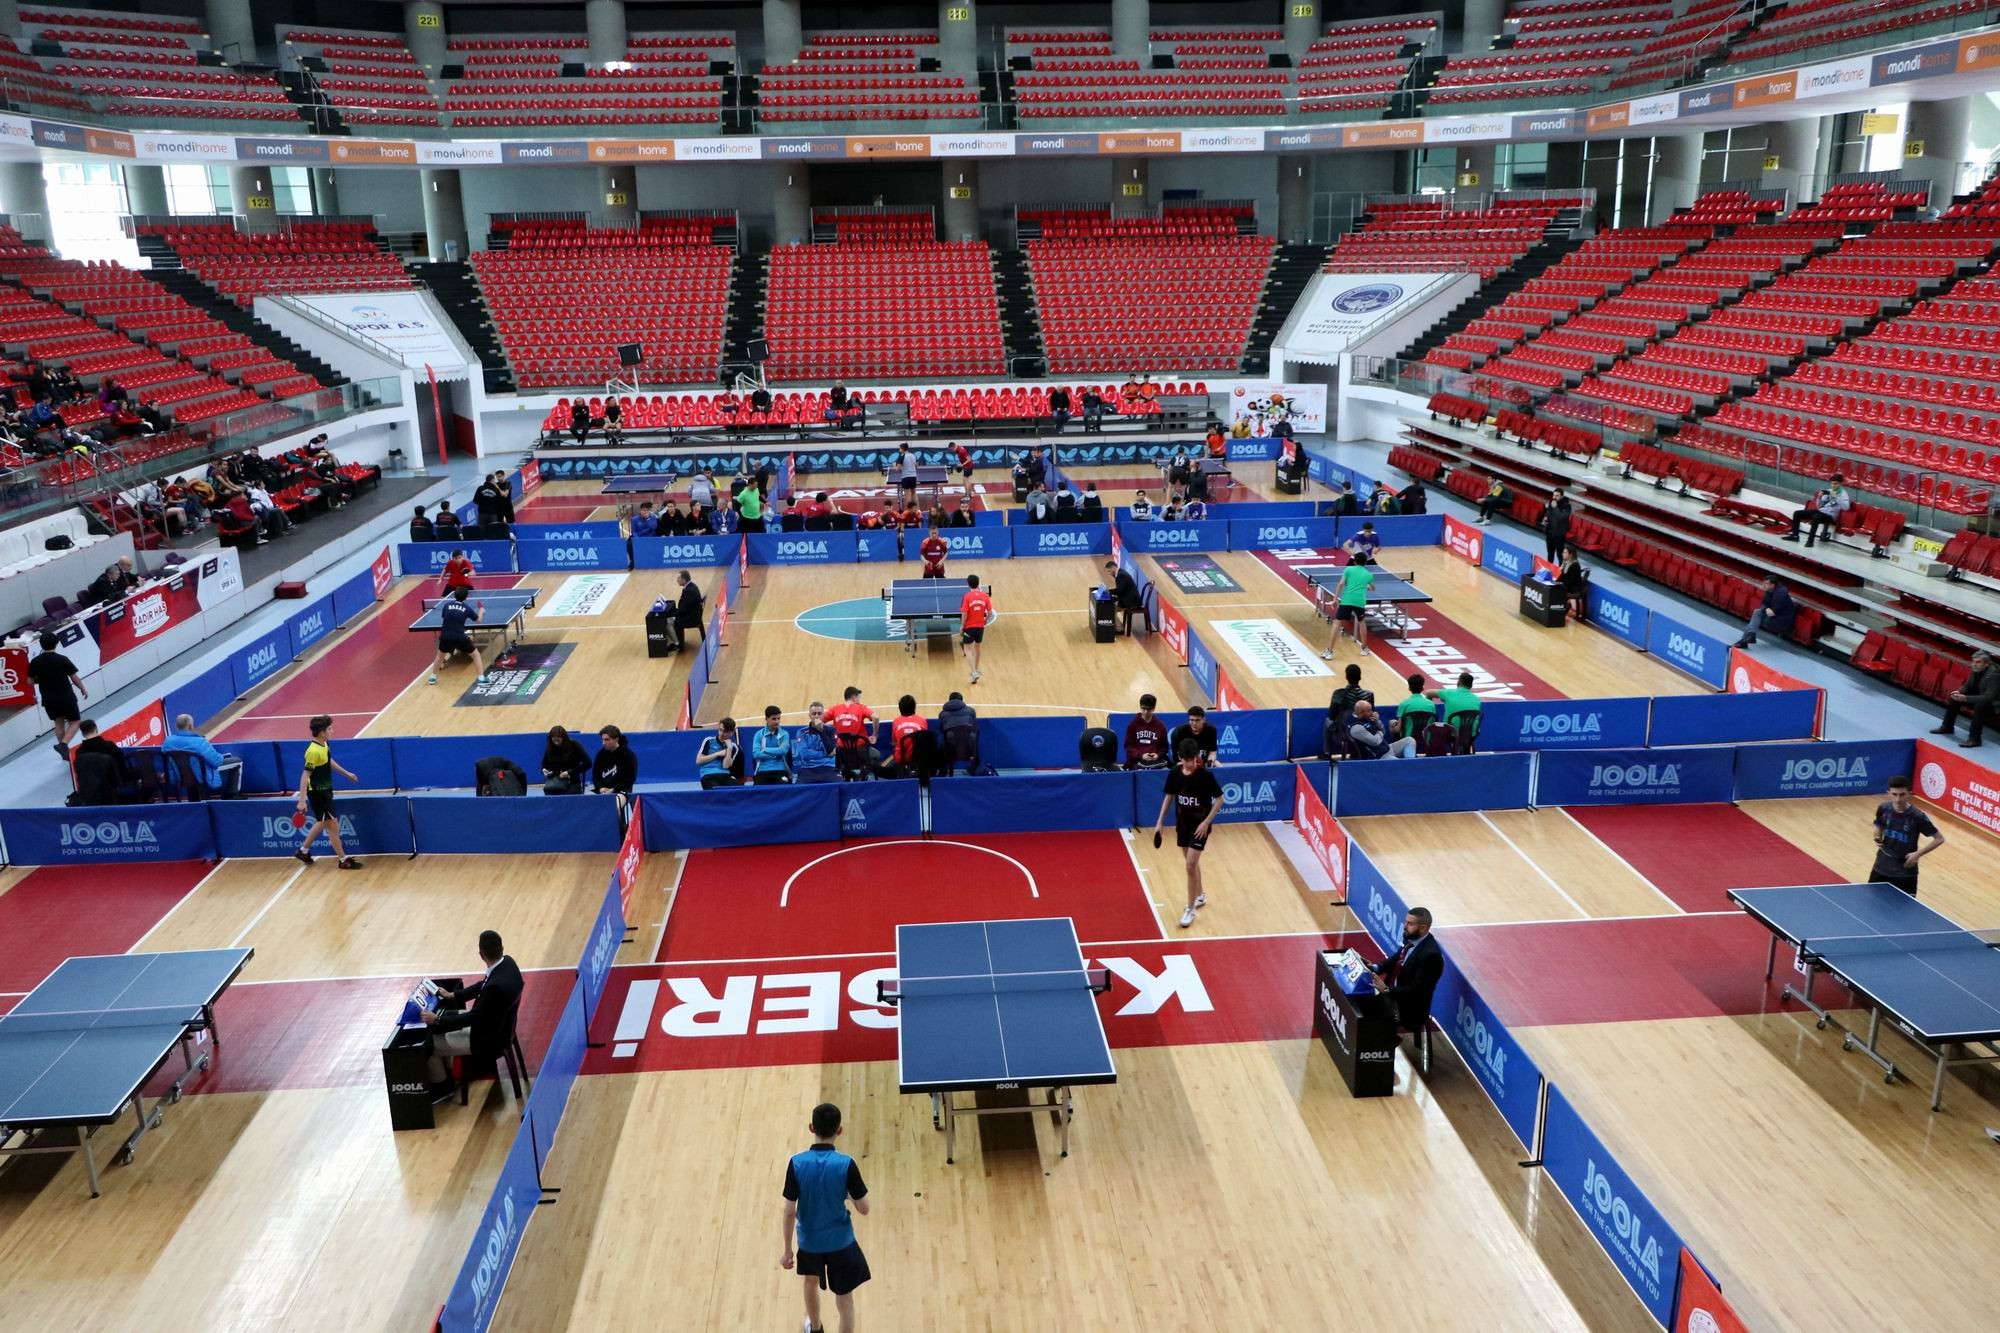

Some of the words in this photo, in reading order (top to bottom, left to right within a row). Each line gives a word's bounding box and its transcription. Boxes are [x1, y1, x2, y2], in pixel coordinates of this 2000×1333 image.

[950, 10, 967, 19] 220
[1294, 6, 1311, 15] 219
[420, 16, 438, 25] 221
[1887, 48, 1951, 75] mondihome
[1811, 67, 1866, 88] mondihome
[1443, 122, 1505, 136] mondihome
[948, 139, 1009, 150] mondihome
[1199, 135, 1257, 146] mondihome
[157, 141, 228, 155] mondihome
[693, 144, 754, 155] mondihome
[251, 199, 270, 208] 122
[1232, 444, 1267, 454] JOOLA
[1039, 532, 1088, 546] JOOLA
[1149, 530, 1199, 543] JOOLA
[1258, 526, 1307, 540] JOOLA
[547, 548, 598, 561] JOOLA
[664, 544, 714, 558] JOOLA
[777, 541, 827, 555] JOOLA
[1495, 549, 1519, 571] JOOLA
[1524, 587, 1543, 606] JOOLA
[132, 609, 153, 627] KADİR
[153, 600, 167, 617] HAS
[1600, 599, 1631, 628] JOOLA
[300, 611, 323, 639] JOOLA
[1239, 631, 1294, 677] NUTRITION
[1259, 631, 1316, 676] HERBALIFE
[1668, 632, 1706, 664] JOOLA
[248, 642, 277, 674] JOOLA
[1520, 713, 1601, 735] JOOLA
[1137, 730, 1158, 741] ISDFL
[1227, 746, 1240, 754] YOU
[1590, 764, 1681, 787] JOOLA
[1781, 756, 1868, 781] JOOLA
[1780, 782, 1794, 791] FOR
[1795, 781, 1808, 790] THE
[1808, 780, 1844, 789] CHAMPION
[1845, 780, 1852, 788] IN
[1854, 780, 1868, 788] YOU
[1952, 787, 1982, 808] GENÇLİK
[1982, 800, 1993, 813] VE
[1954, 799, 1961, 813] İL
[1262, 804, 1277, 812] YOU
[60, 821, 158, 846] JOOLA
[852, 823, 867, 831] YOU
[143, 845, 159, 853] YOU
[1368, 886, 1406, 948] JOOLA
[590, 915, 613, 976] JOOLA
[612, 953, 1214, 1057] KSERİ
[1320, 982, 1347, 1039] JOOLA
[1457, 996, 1504, 1086] JOOLA
[1360, 1050, 1390, 1060] JOOLA
[392, 1081, 424, 1092] JOOLA
[1583, 1158, 1661, 1284] JOOLA
[1581, 1194, 1594, 1216] FOR
[1593, 1210, 1606, 1231] THE
[1605, 1223, 1641, 1275] CHAMPION
[1637, 1265, 1645, 1281] IN
[1645, 1275, 1660, 1301] YOU
[471, 1193, 514, 1318] JOOLA
